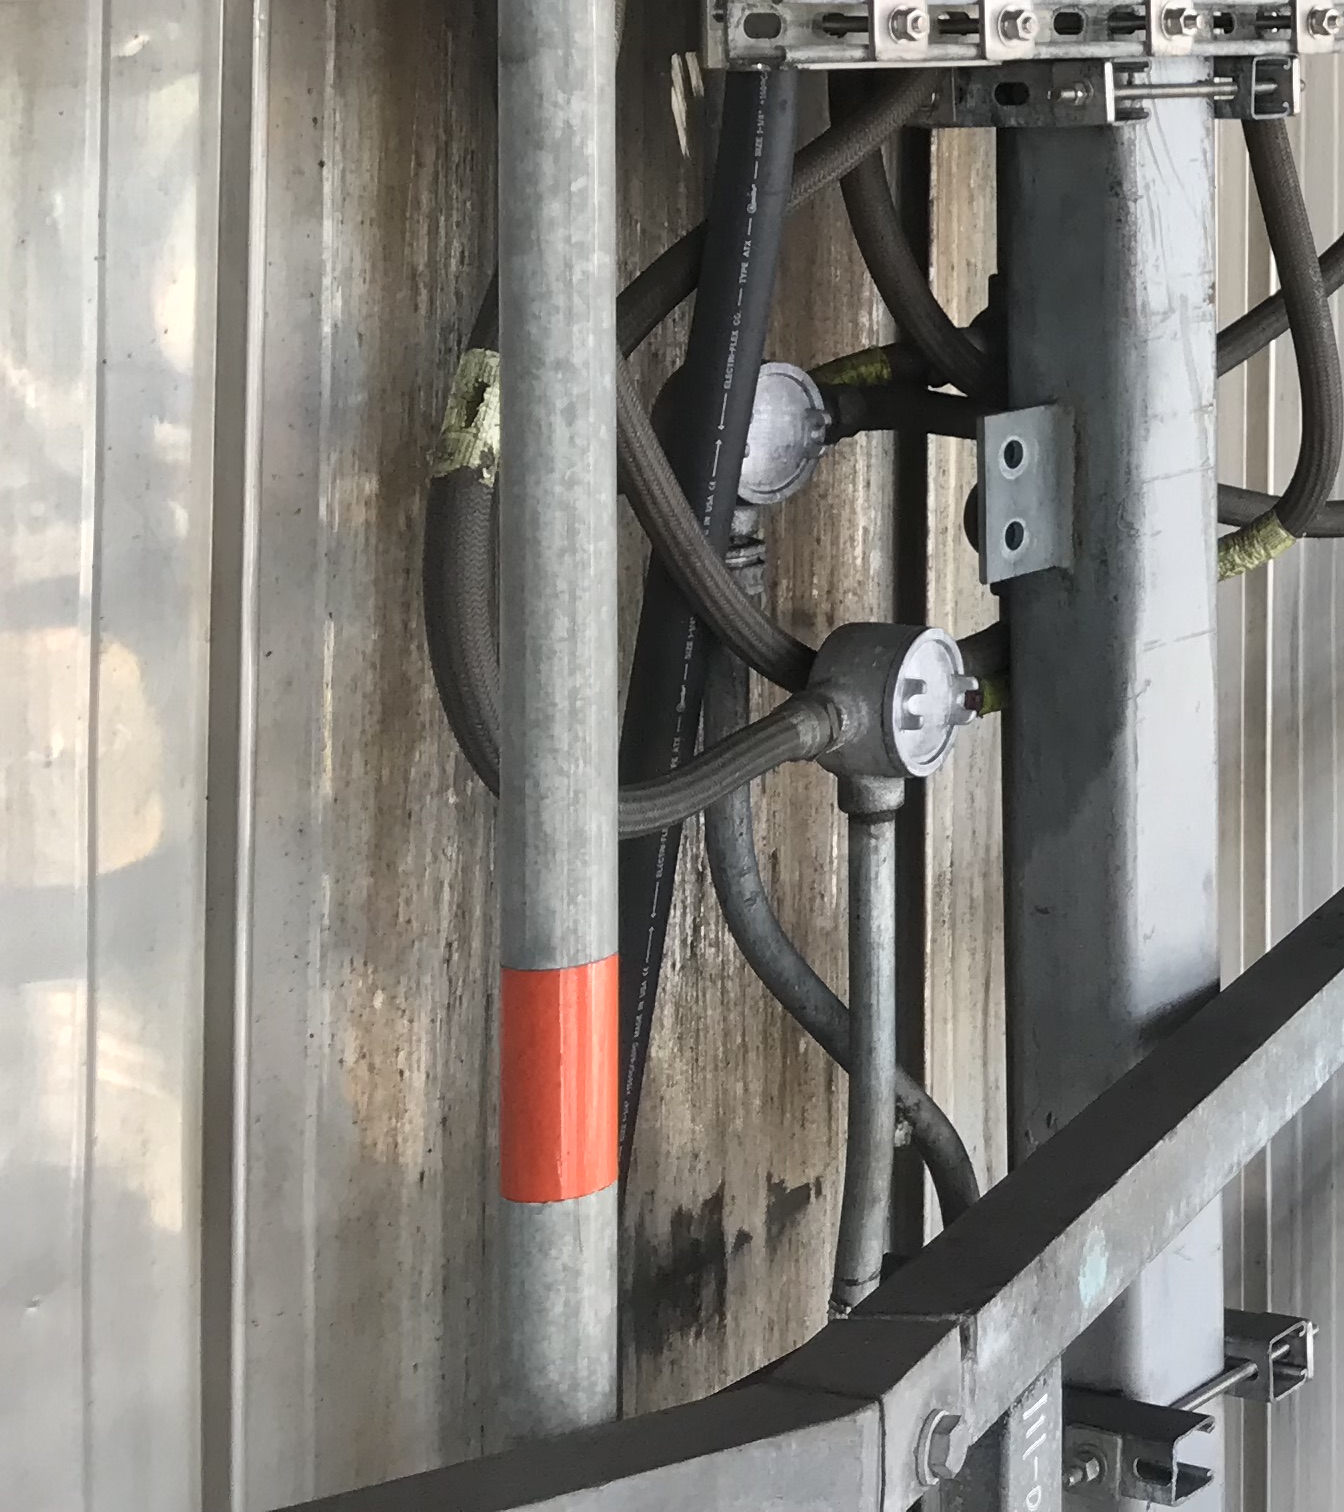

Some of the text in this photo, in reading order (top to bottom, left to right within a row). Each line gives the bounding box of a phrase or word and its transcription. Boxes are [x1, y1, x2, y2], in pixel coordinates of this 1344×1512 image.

[743, 241, 751, 257] ATX
[739, 263, 748, 283] TYPE
[724, 330, 738, 389] ELECTRI-FLEX
[706, 495, 714, 512] USA
[655, 827, 668, 878] ELECTRI-FLE
